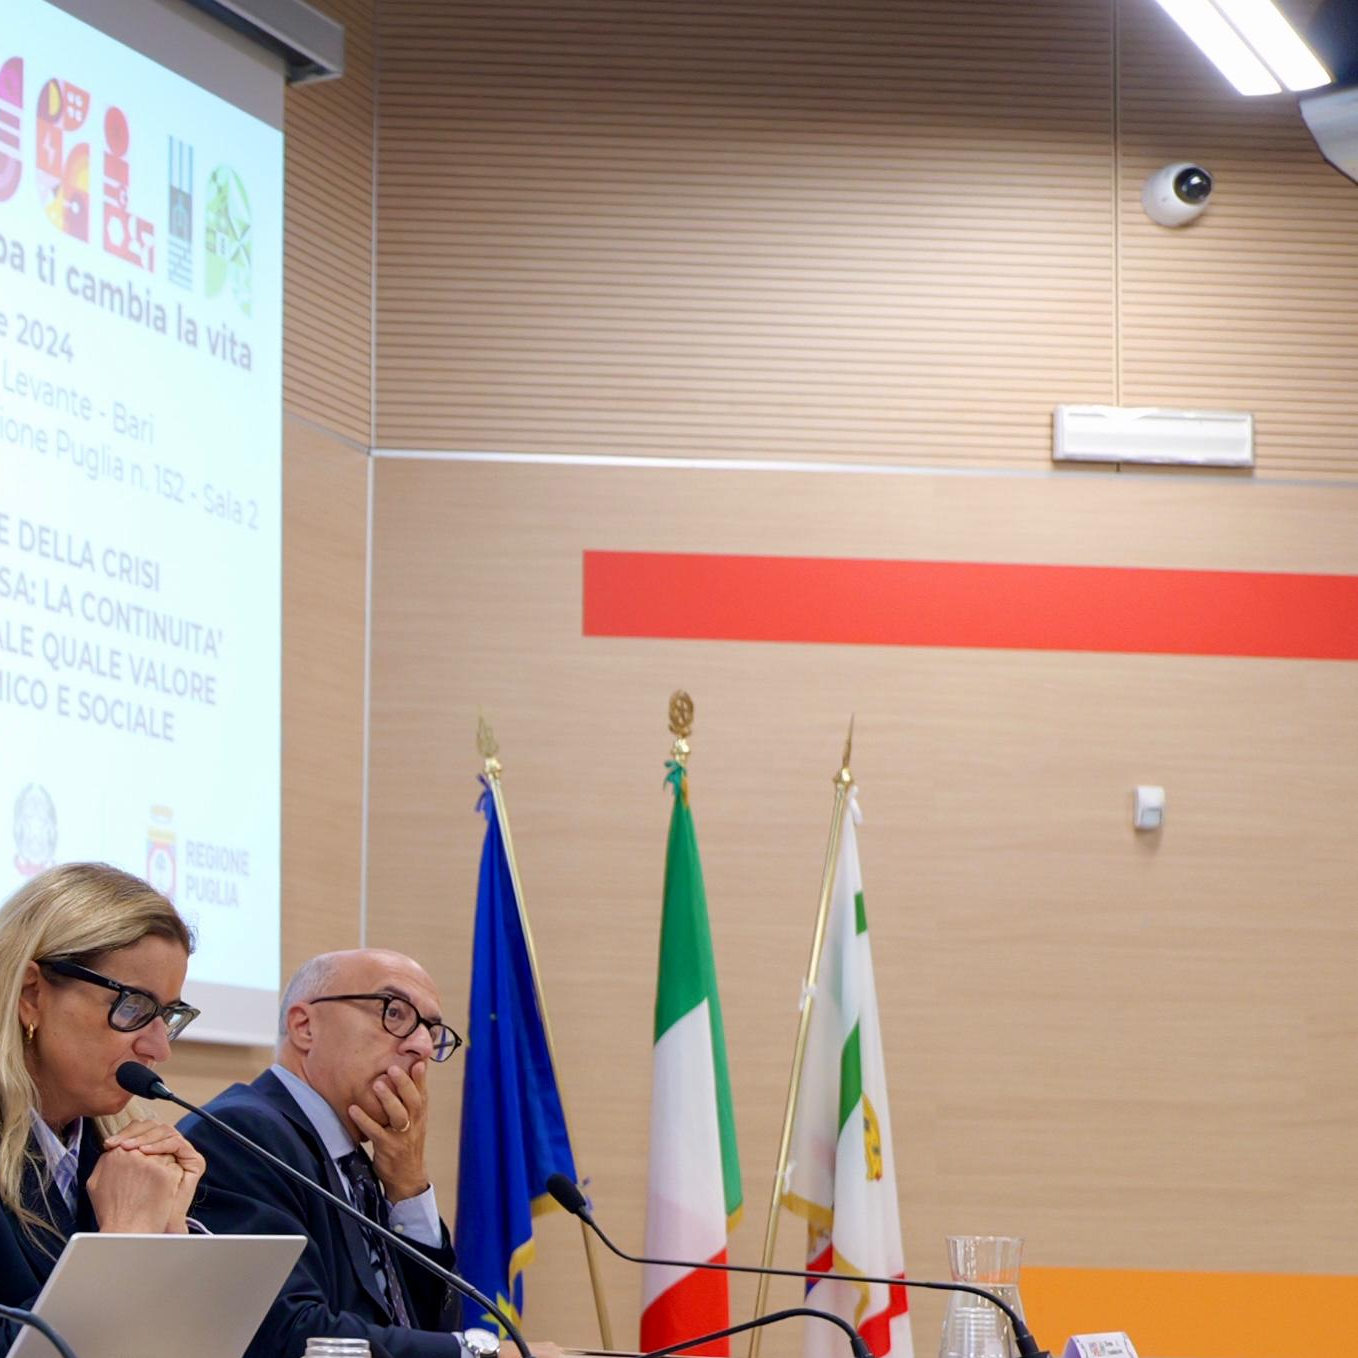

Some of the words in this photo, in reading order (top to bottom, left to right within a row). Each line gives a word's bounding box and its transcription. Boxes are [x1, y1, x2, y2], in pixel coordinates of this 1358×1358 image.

[16, 312, 75, 363] 2024
[36, 243, 56, 287] ti
[66, 264, 167, 335] cambia
[177, 303, 198, 348] la
[206, 322, 253, 371] vita
[2, 358, 93, 421] Levante
[113, 401, 155, 446] Bari
[56, 428, 124, 482] Puglia
[154, 463, 185, 504] 152
[203, 483, 243, 525] Sala
[247, 499, 259, 531] 2
[19, 518, 96, 573] DELLA
[102, 547, 161, 594] CRISI
[44, 578, 74, 617] LA
[80, 591, 224, 660] CONTINUITA'
[42, 631, 122, 681] QUALE
[128, 652, 217, 706] VALORE
[57, 683, 71, 717] E
[78, 690, 175, 743] SOCIALE
[185, 840, 250, 877] REGIONE
[185, 874, 239, 908] PUGLIA
